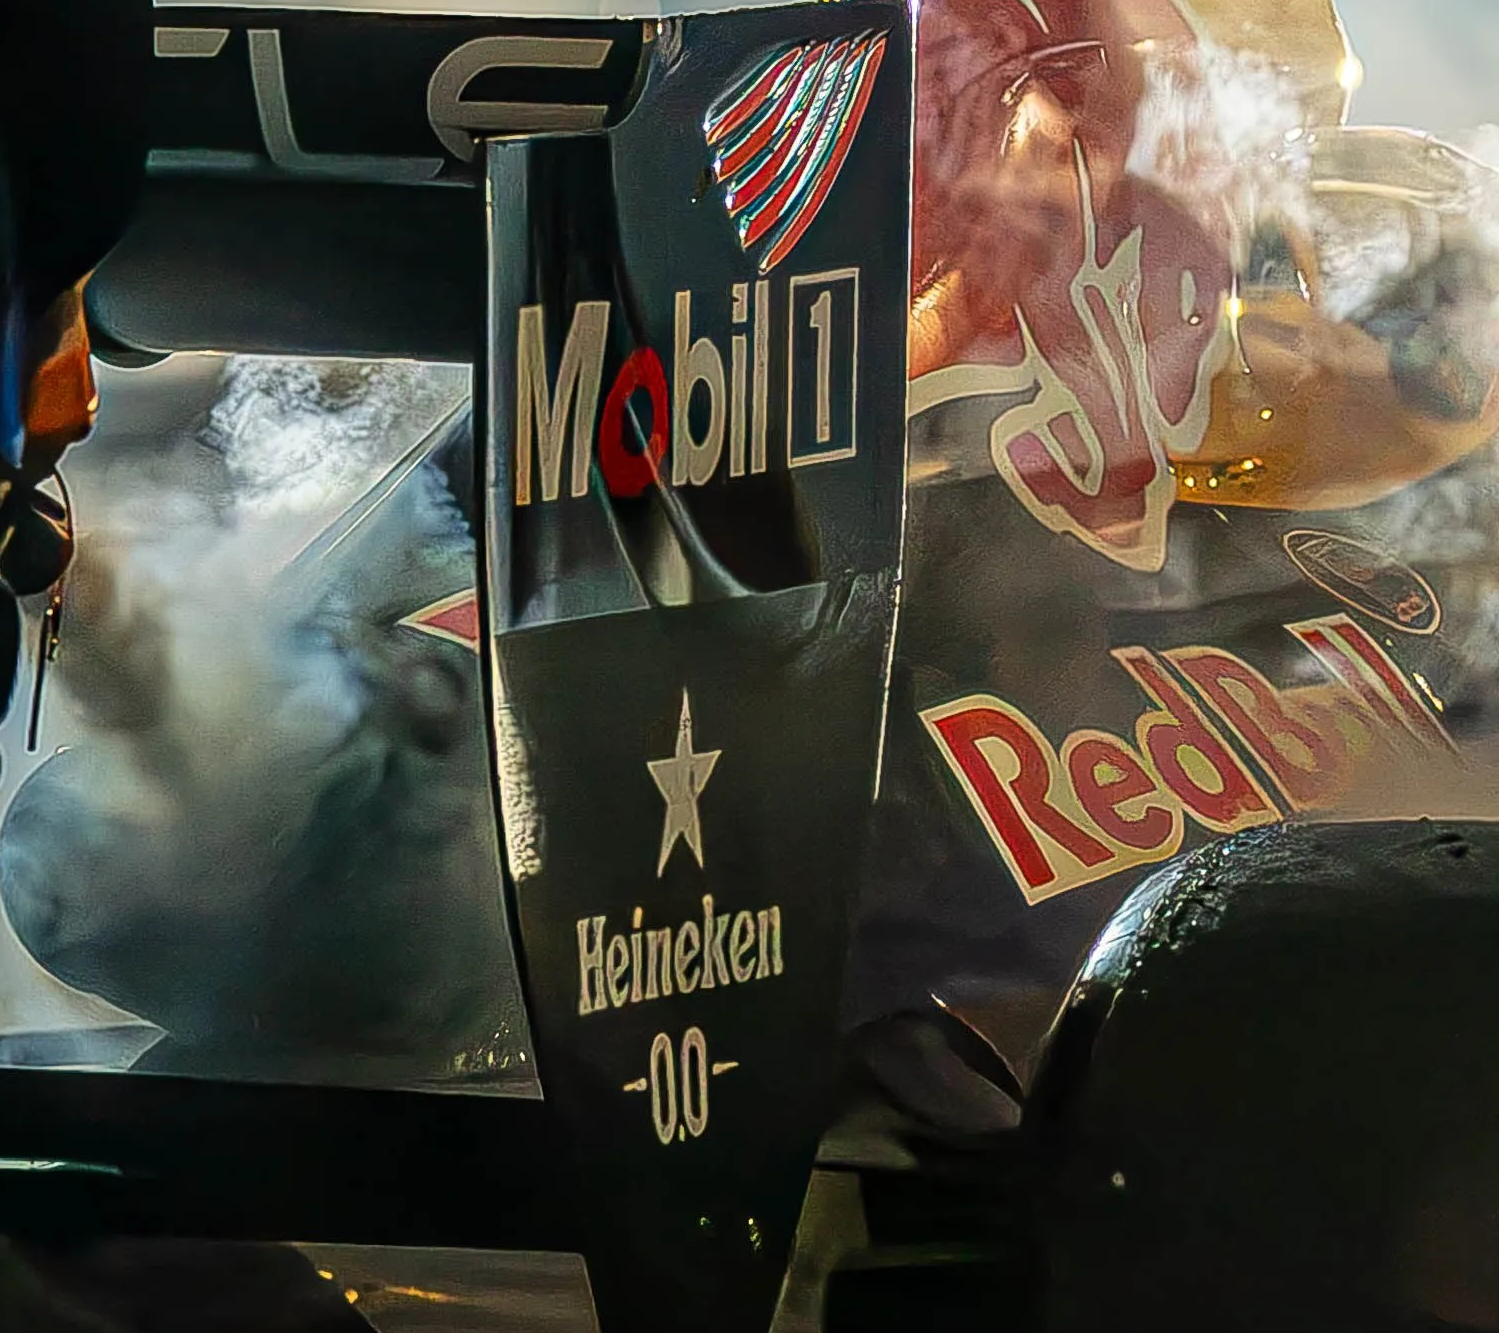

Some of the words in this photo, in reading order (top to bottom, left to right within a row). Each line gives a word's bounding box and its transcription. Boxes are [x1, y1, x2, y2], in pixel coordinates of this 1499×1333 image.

[514, 278, 771, 509] Mobil
[918, 645, 1287, 906] Red
[576, 894, 785, 1016] Heineken
